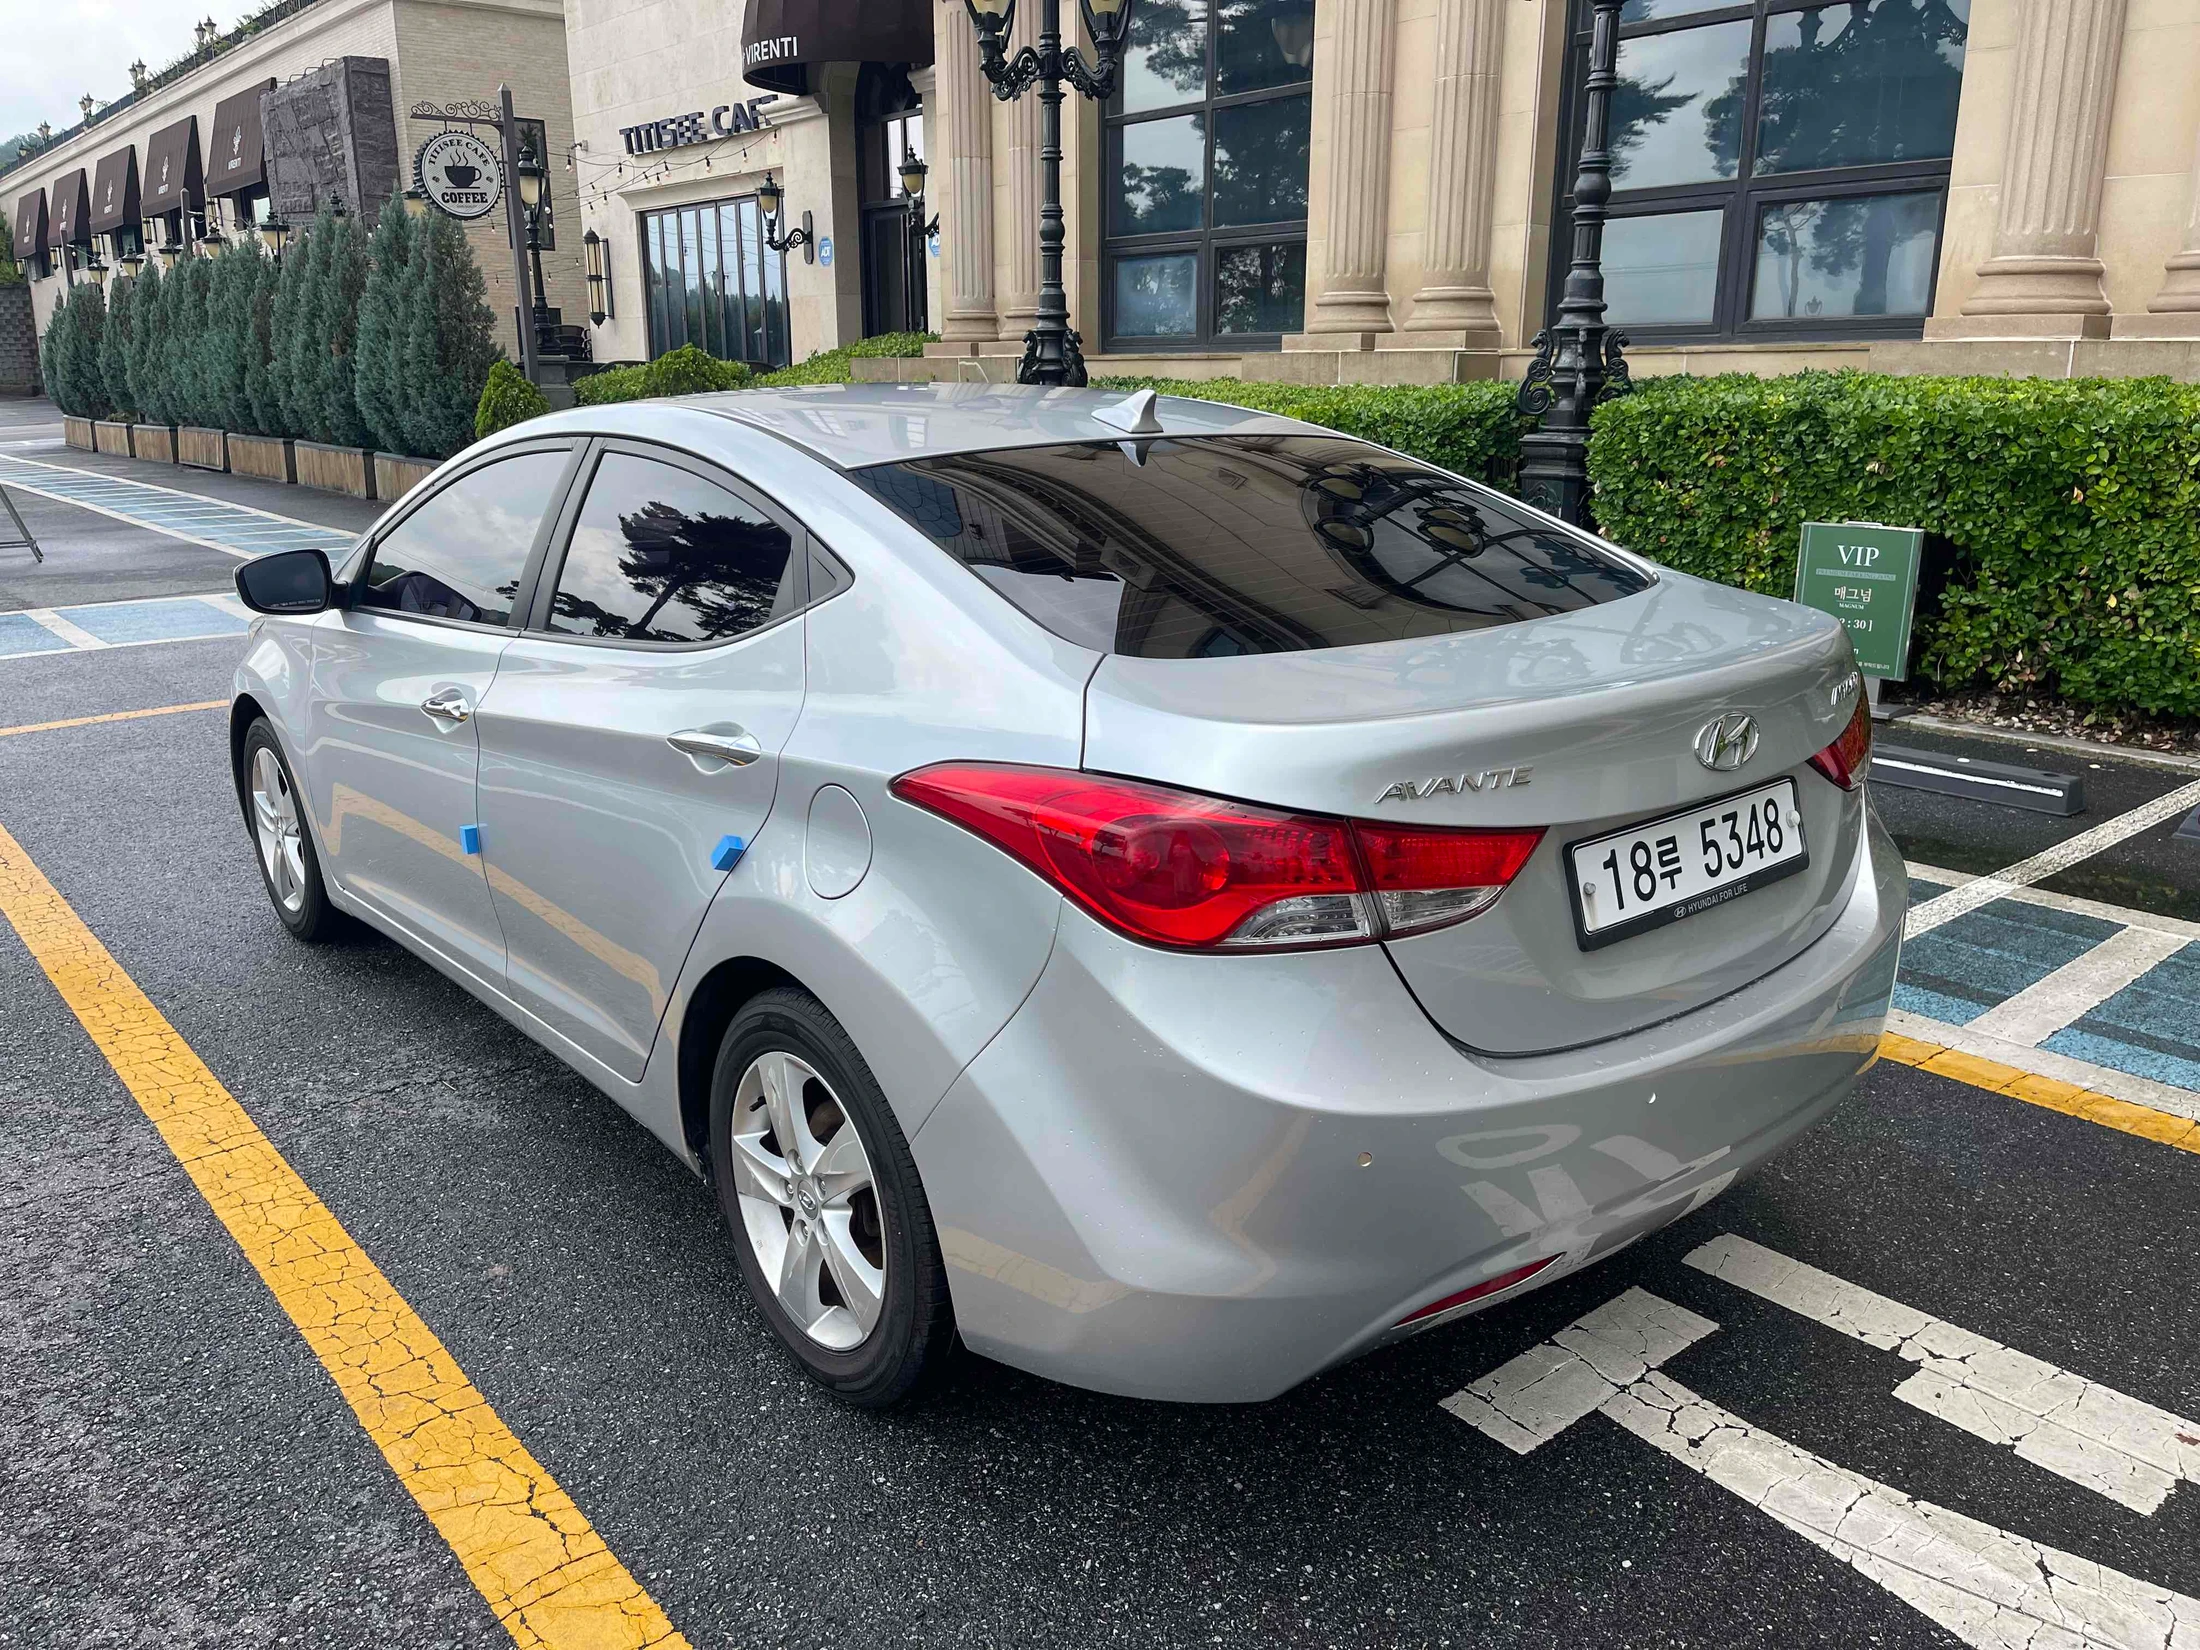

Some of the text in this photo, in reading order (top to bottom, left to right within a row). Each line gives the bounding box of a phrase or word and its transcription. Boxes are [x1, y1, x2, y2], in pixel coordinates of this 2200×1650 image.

[745, 36, 798, 65] VIRENTI
[619, 111, 708, 155] TITISEE
[428, 138, 491, 167] TITISEE CAFE
[441, 191, 488, 204] COFFEE
[1837, 544, 1880, 567] VIP
[1834, 586, 1872, 603] 매그넘
[1839, 602, 1865, 610] MAGNUM
[1374, 765, 1534, 804] AVANTE
[1602, 798, 1784, 911] 18루 5348
[1687, 883, 1748, 913] HYUNDAI FOR LIFE
